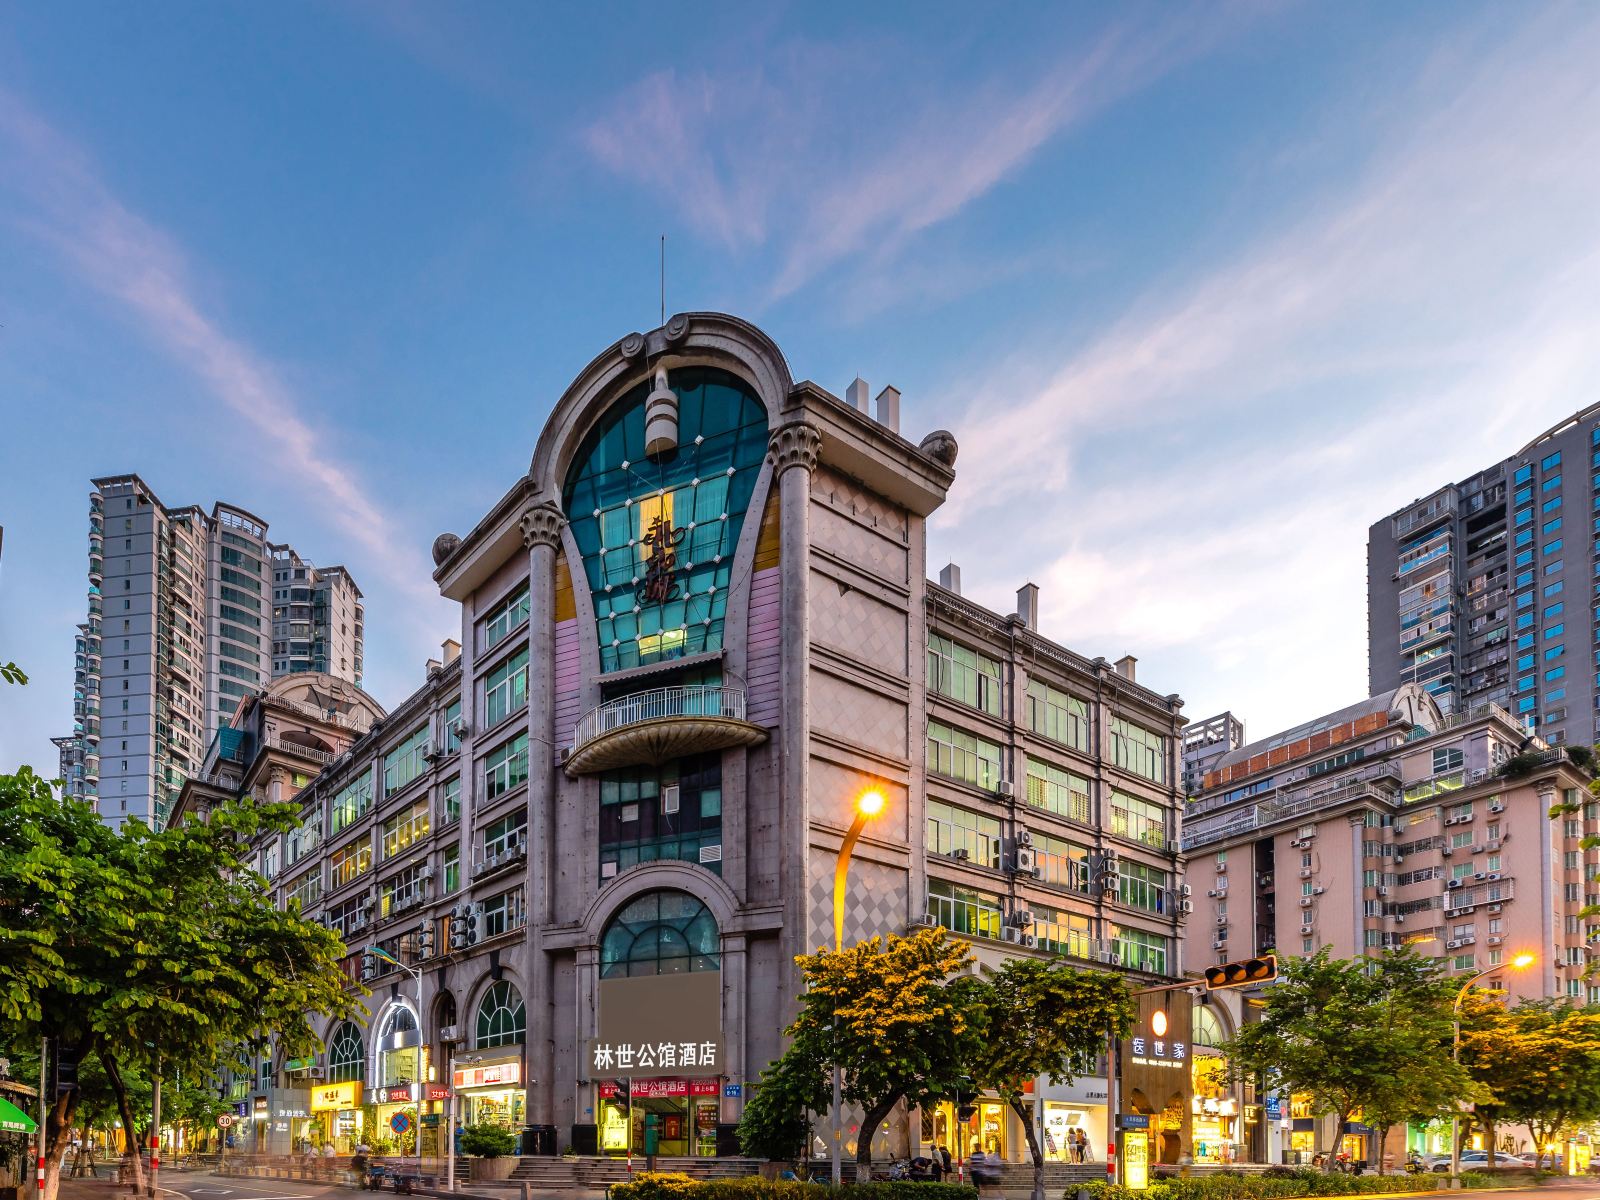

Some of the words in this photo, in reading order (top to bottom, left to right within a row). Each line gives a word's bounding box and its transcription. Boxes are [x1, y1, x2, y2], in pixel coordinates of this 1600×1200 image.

[593, 1040, 717, 1070] 林世公馆酒店
[631, 1081, 686, 1093] 林世公馆酒店
[220, 1117, 230, 1125] 30
